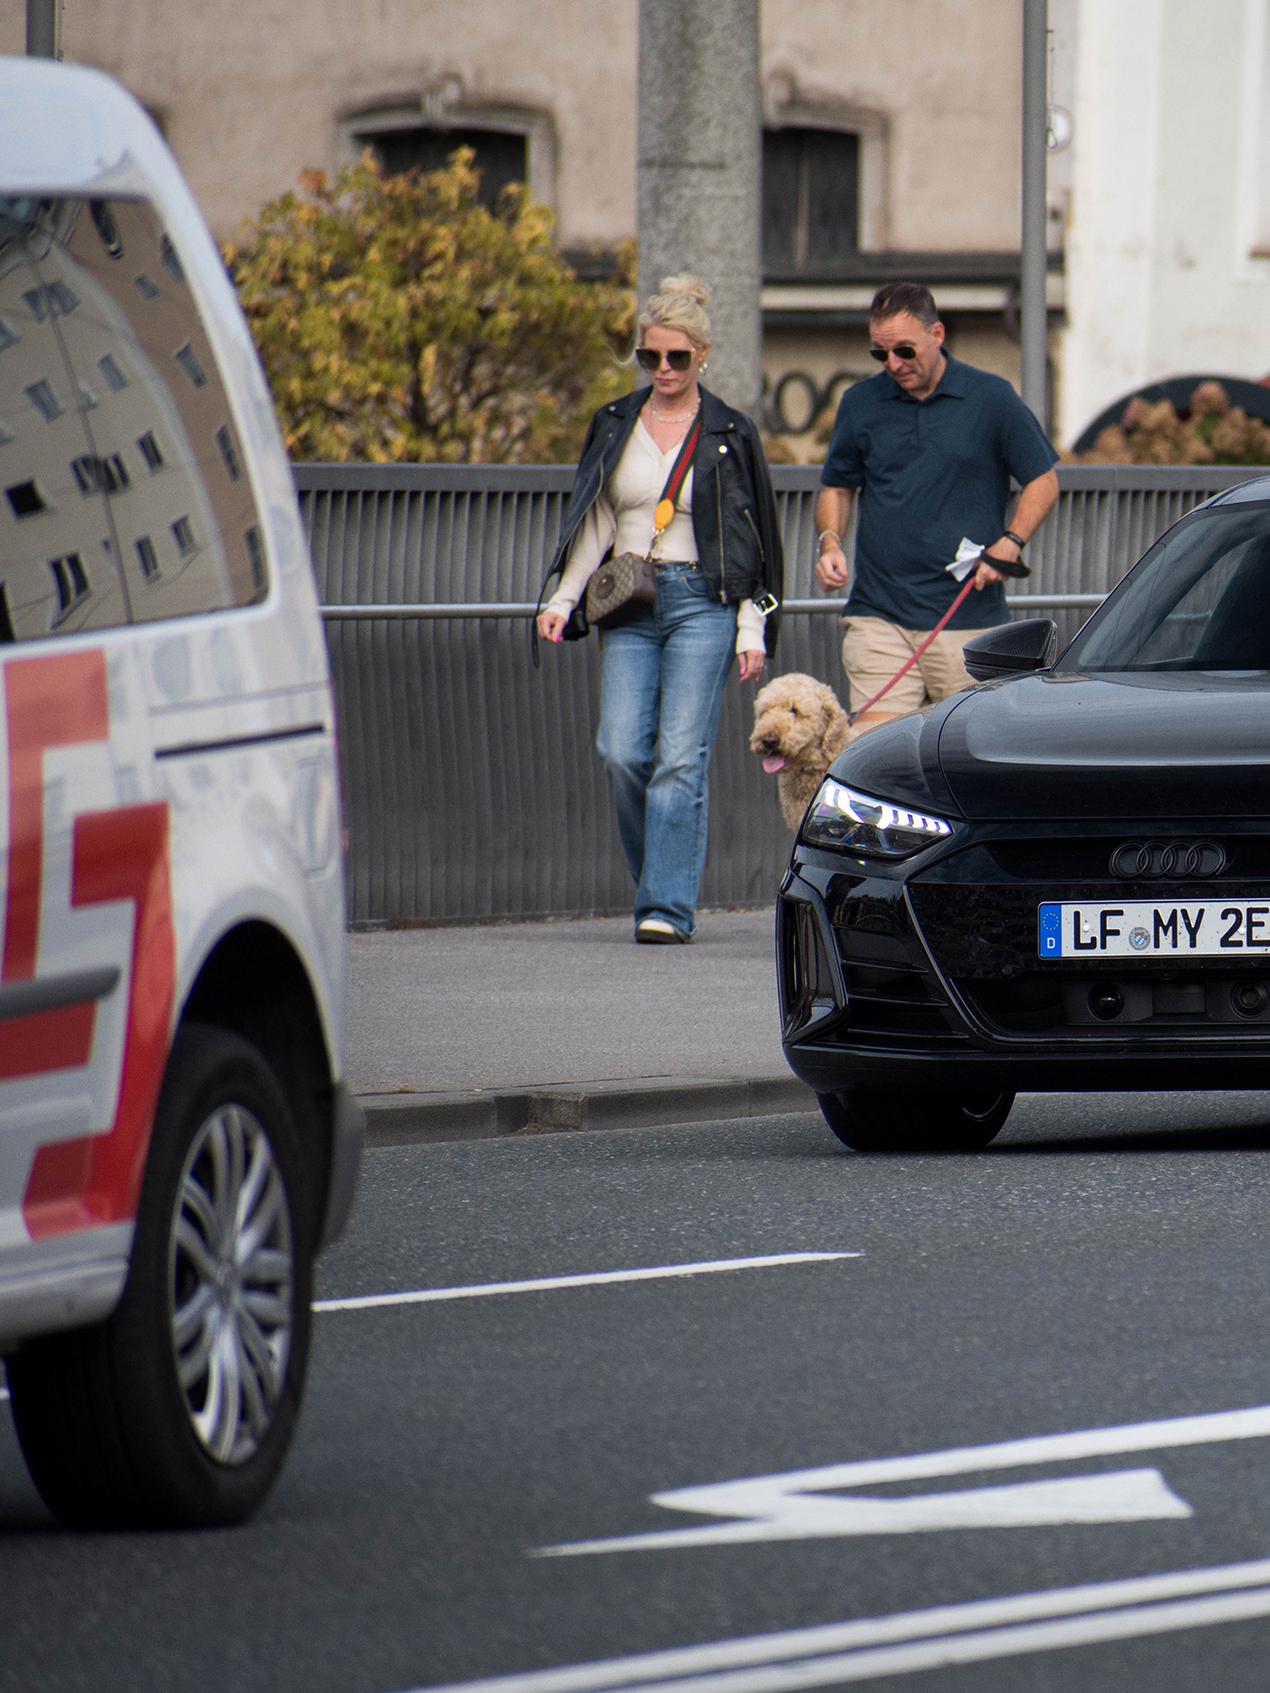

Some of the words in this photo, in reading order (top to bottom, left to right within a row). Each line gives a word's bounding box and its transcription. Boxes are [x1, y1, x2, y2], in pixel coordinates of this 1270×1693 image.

[1046, 937, 1056, 949] D
[1073, 909, 1124, 951] LF
[1153, 908, 1205, 949] MY
